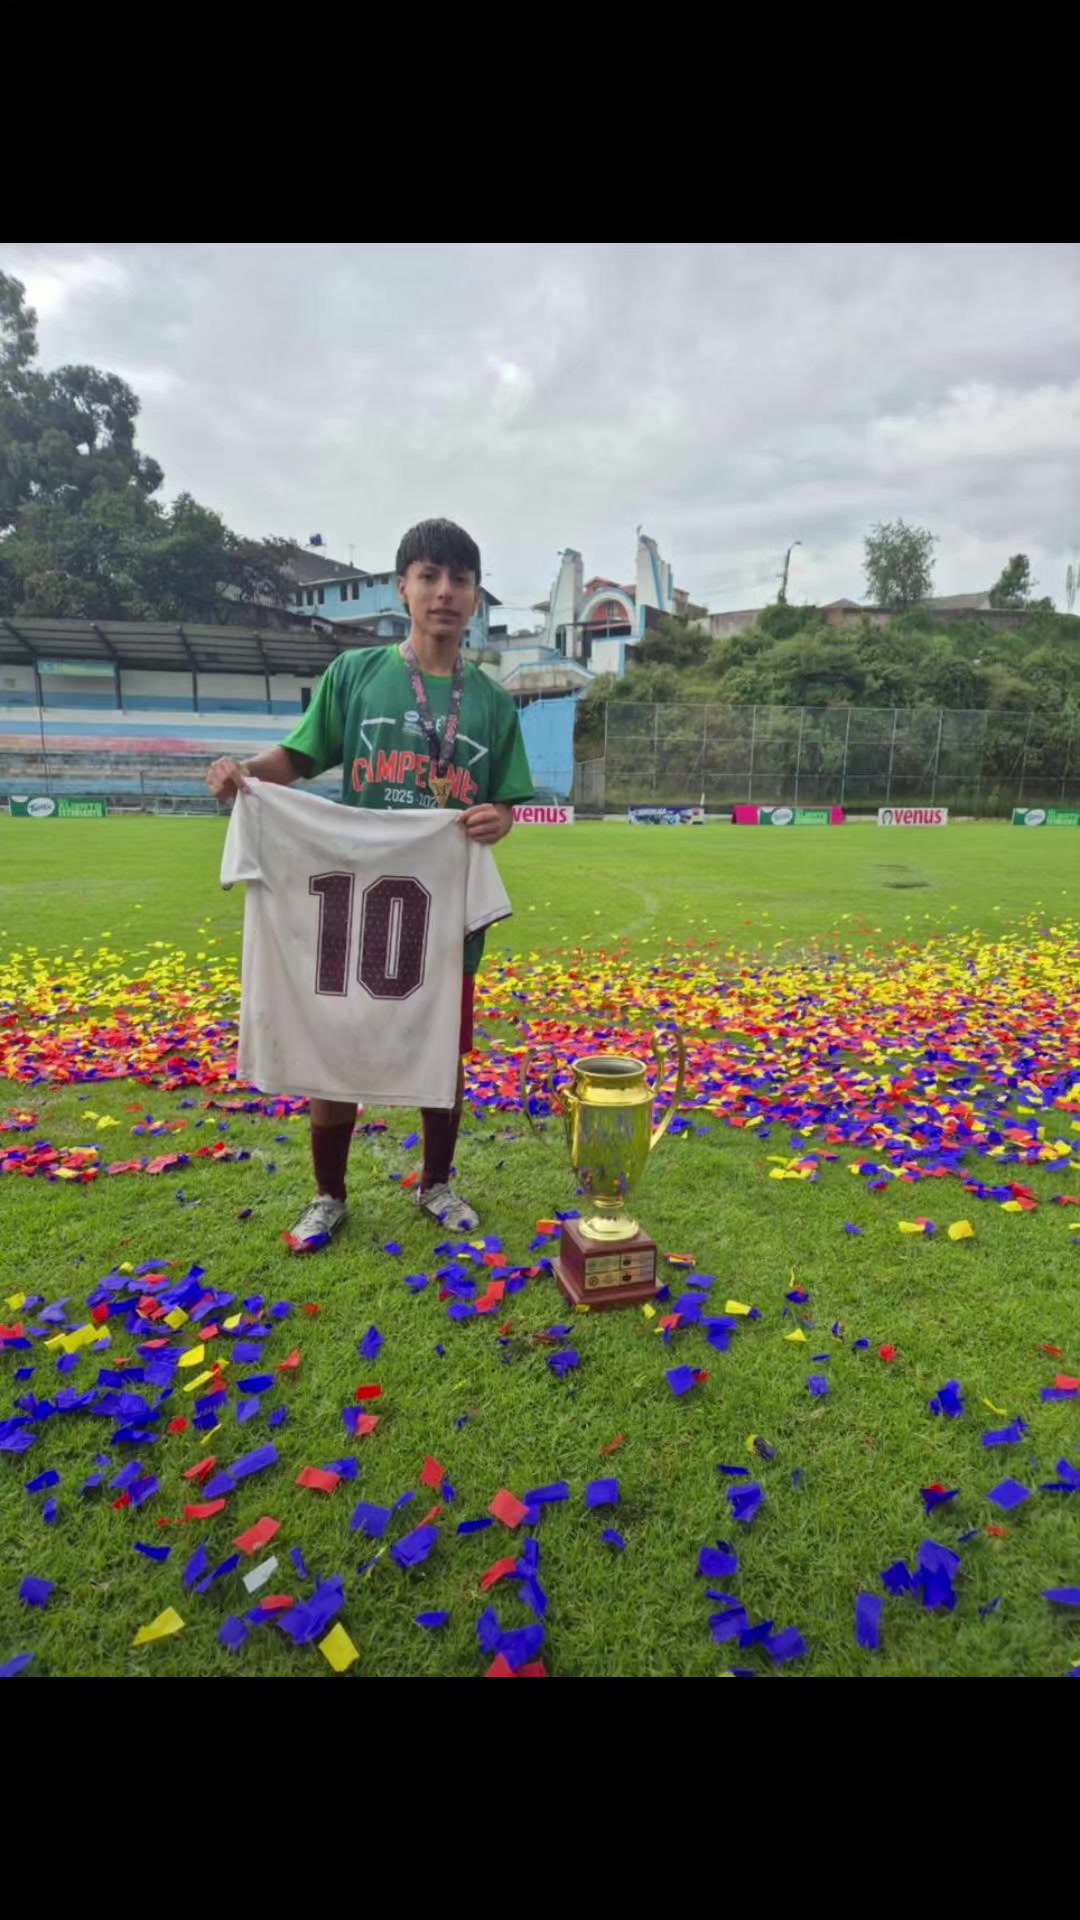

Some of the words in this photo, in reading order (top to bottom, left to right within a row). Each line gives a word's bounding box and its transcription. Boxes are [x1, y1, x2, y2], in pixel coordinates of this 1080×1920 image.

[512, 807, 567, 823] venus
[894, 809, 942, 824] venus
[309, 871, 431, 1000] 10
